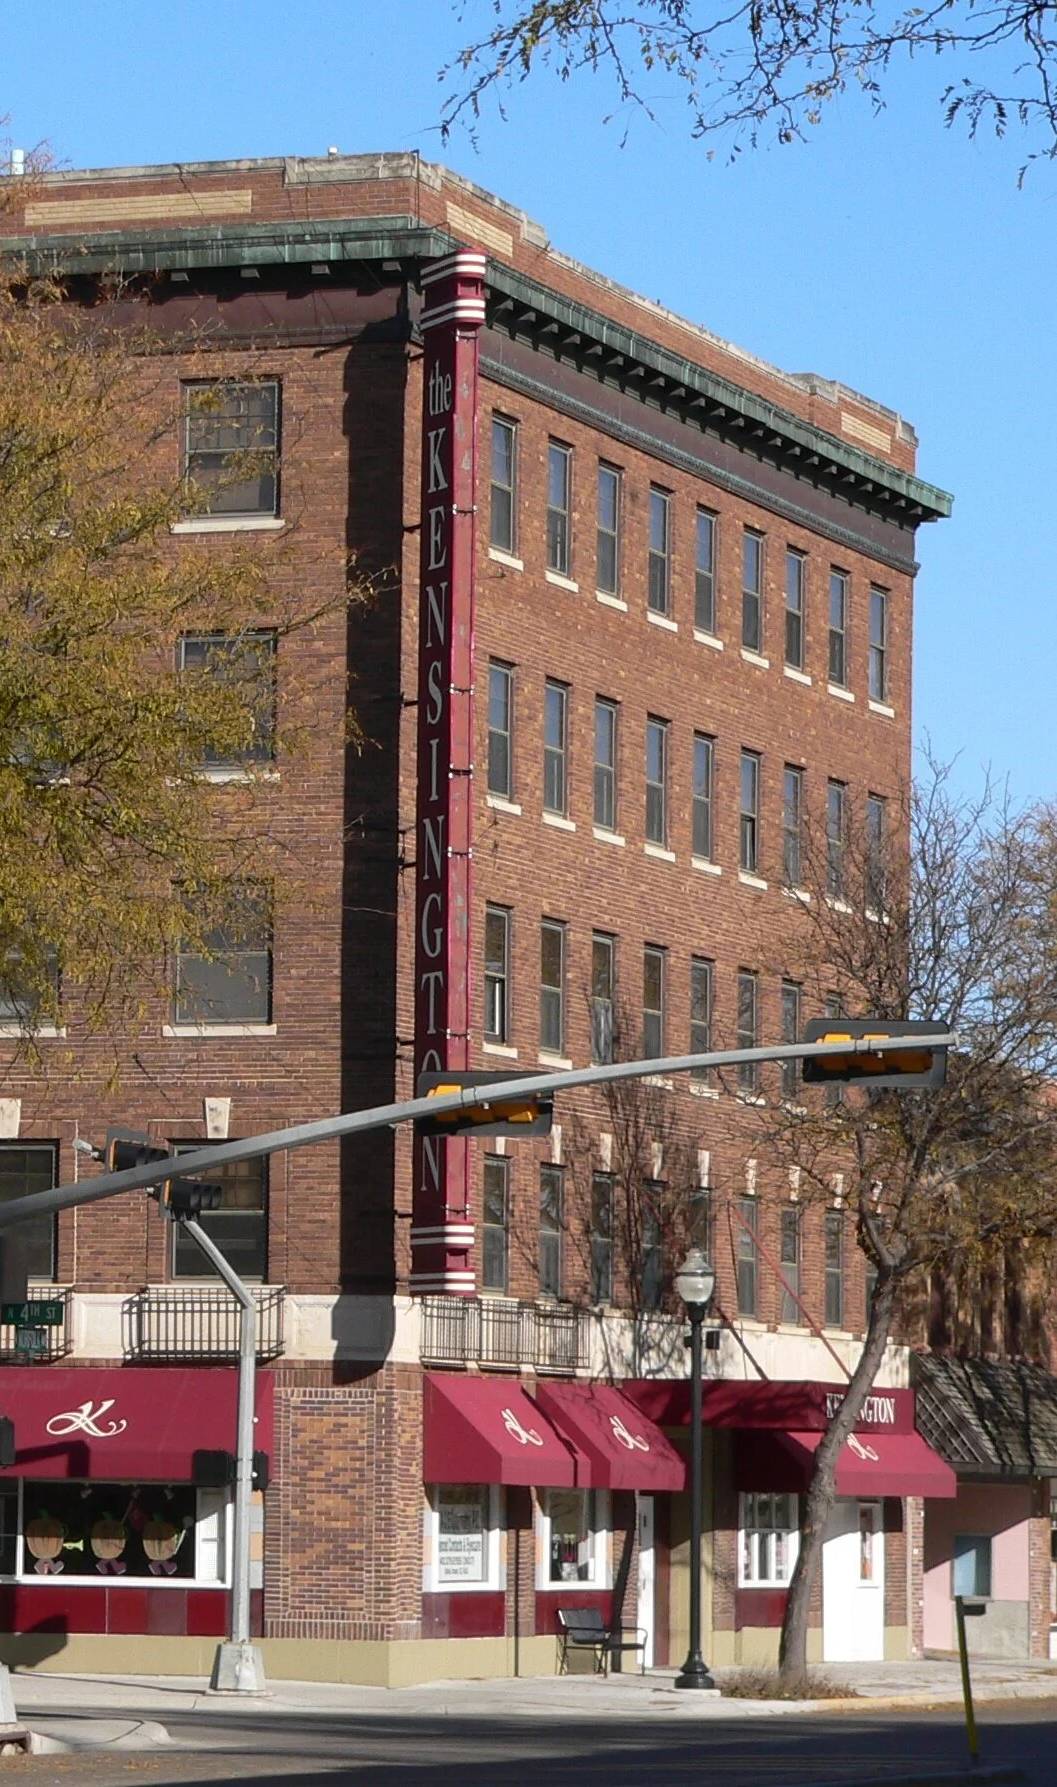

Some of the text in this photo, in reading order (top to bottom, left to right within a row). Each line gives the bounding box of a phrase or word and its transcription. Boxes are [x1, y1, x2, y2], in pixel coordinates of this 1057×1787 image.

[428, 360, 452, 417] the
[20, 1303, 40, 1321] 4TH
[45, 1306, 56, 1320] ST
[826, 1393, 895, 1424] KEGTON
